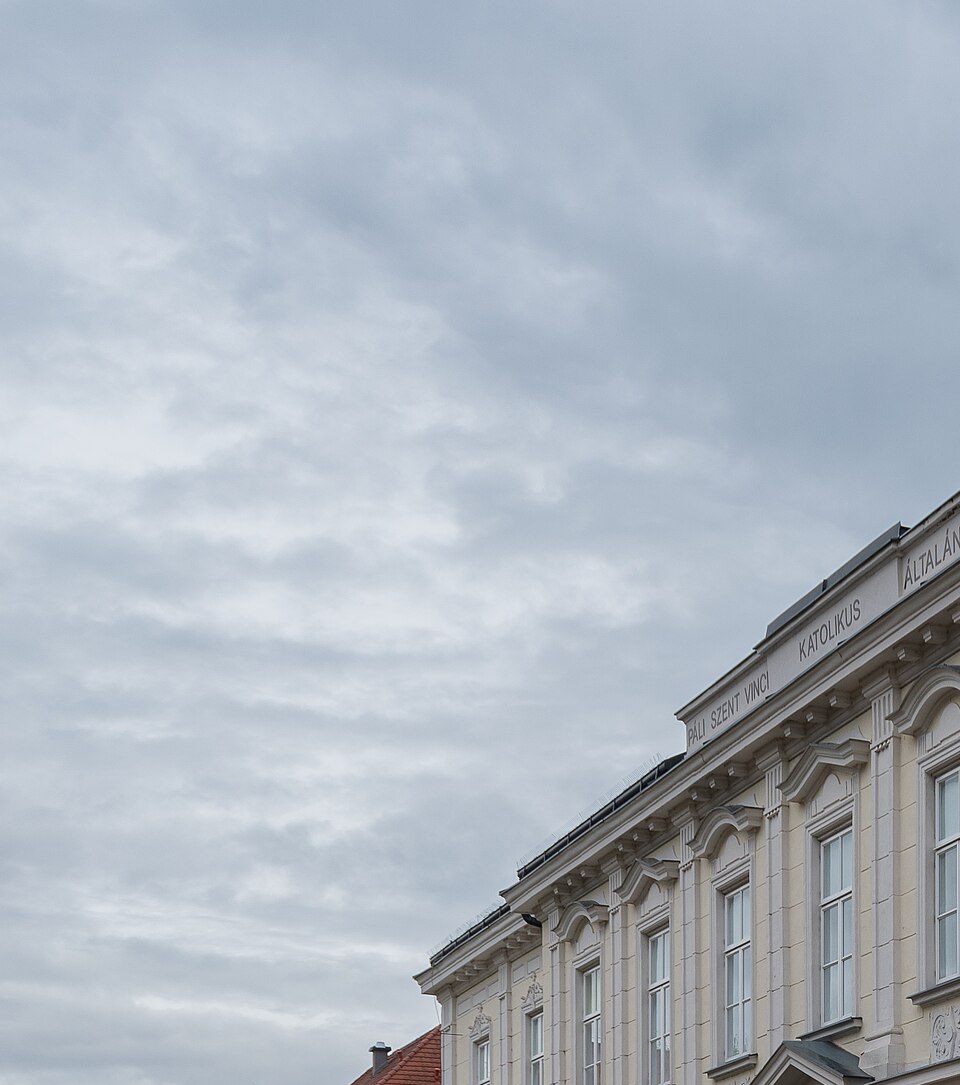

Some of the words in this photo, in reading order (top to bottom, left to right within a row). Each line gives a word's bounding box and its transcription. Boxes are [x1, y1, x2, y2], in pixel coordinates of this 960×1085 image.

[688, 718, 706, 747] PÁLI
[710, 692, 740, 730] SZENT
[744, 670, 770, 704] VINCI
[799, 599, 861, 662] KATOLIKUS
